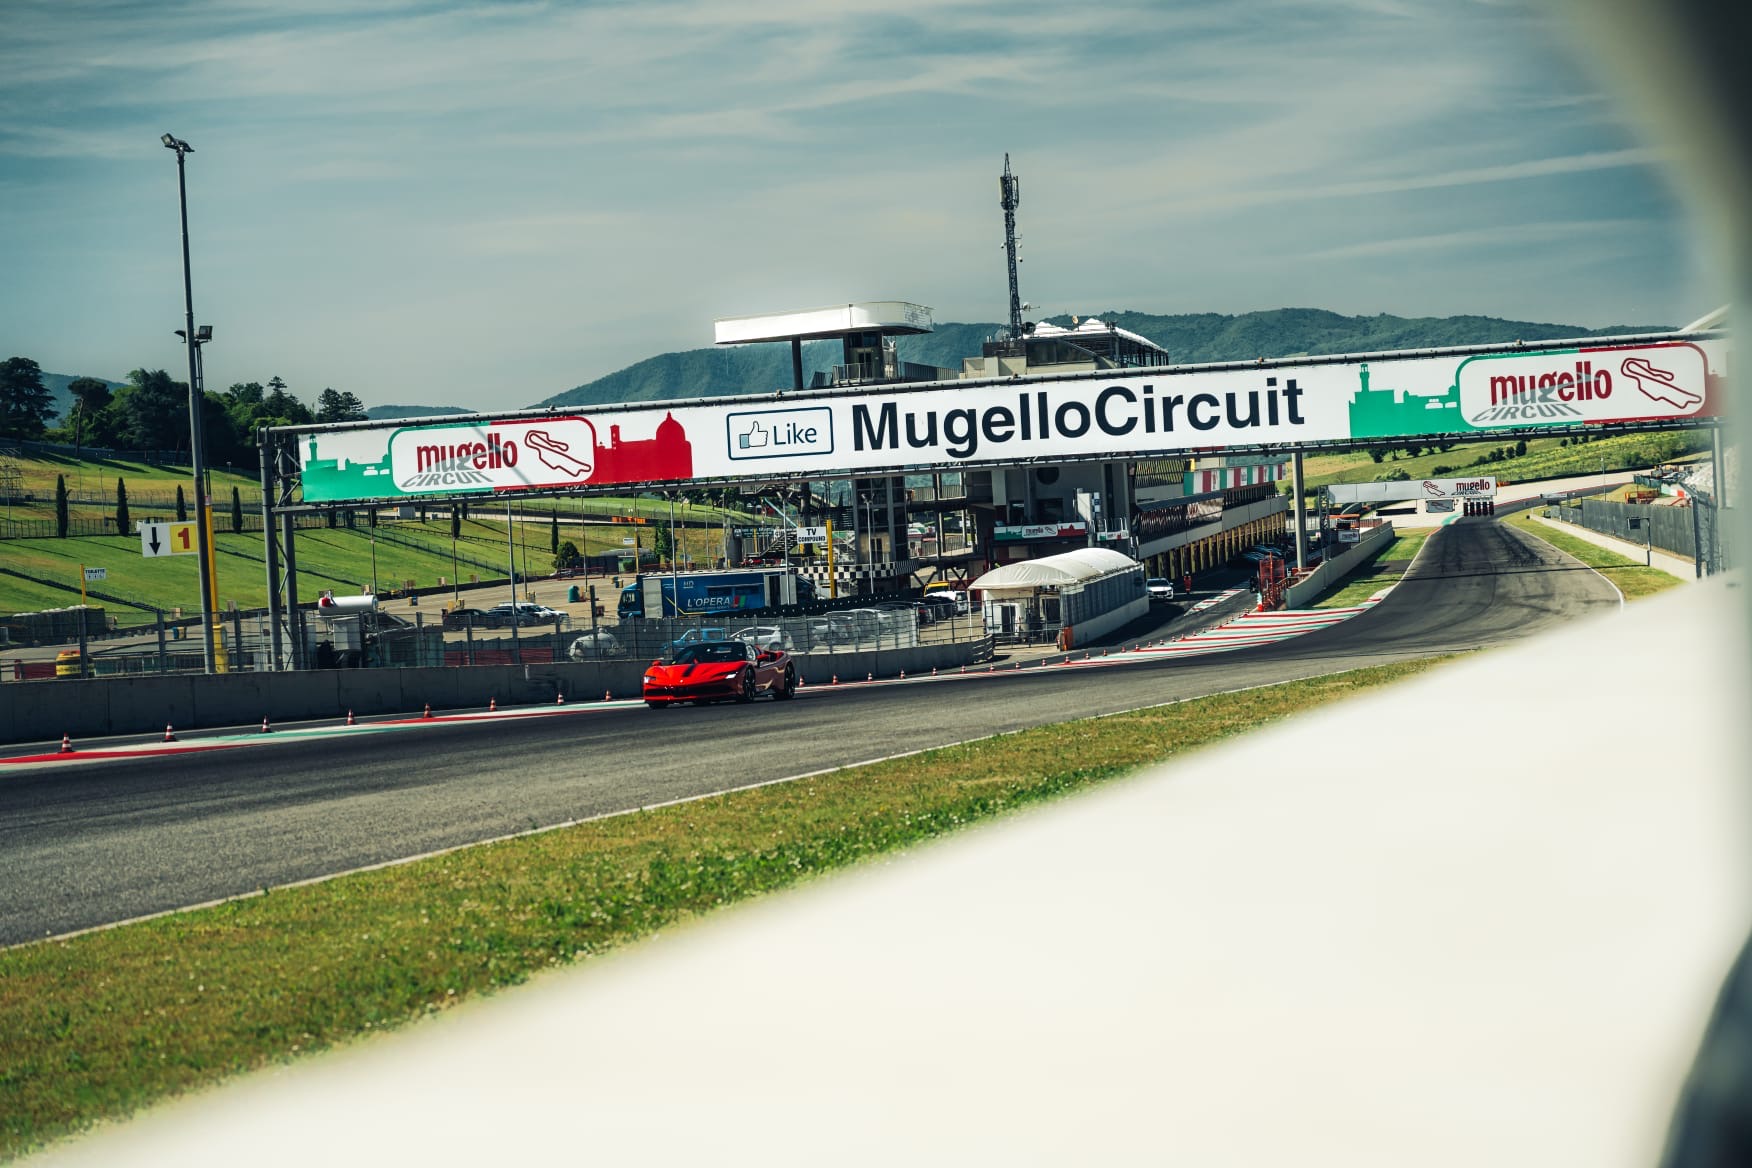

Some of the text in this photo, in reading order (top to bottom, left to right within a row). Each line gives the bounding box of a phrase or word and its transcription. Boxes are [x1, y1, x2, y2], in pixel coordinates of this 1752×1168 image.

[1490, 361, 1612, 406] mugello
[852, 377, 1305, 459] MugelloCircuit
[1472, 403, 1583, 422] CIRCUIT
[773, 422, 817, 445] Like
[416, 433, 518, 473] mugello
[401, 471, 494, 487] CIRCUIT
[1456, 479, 1490, 491] mugello
[178, 527, 190, 549] 1
[806, 528, 817, 536] TV
[687, 597, 730, 607] L'OPERA
